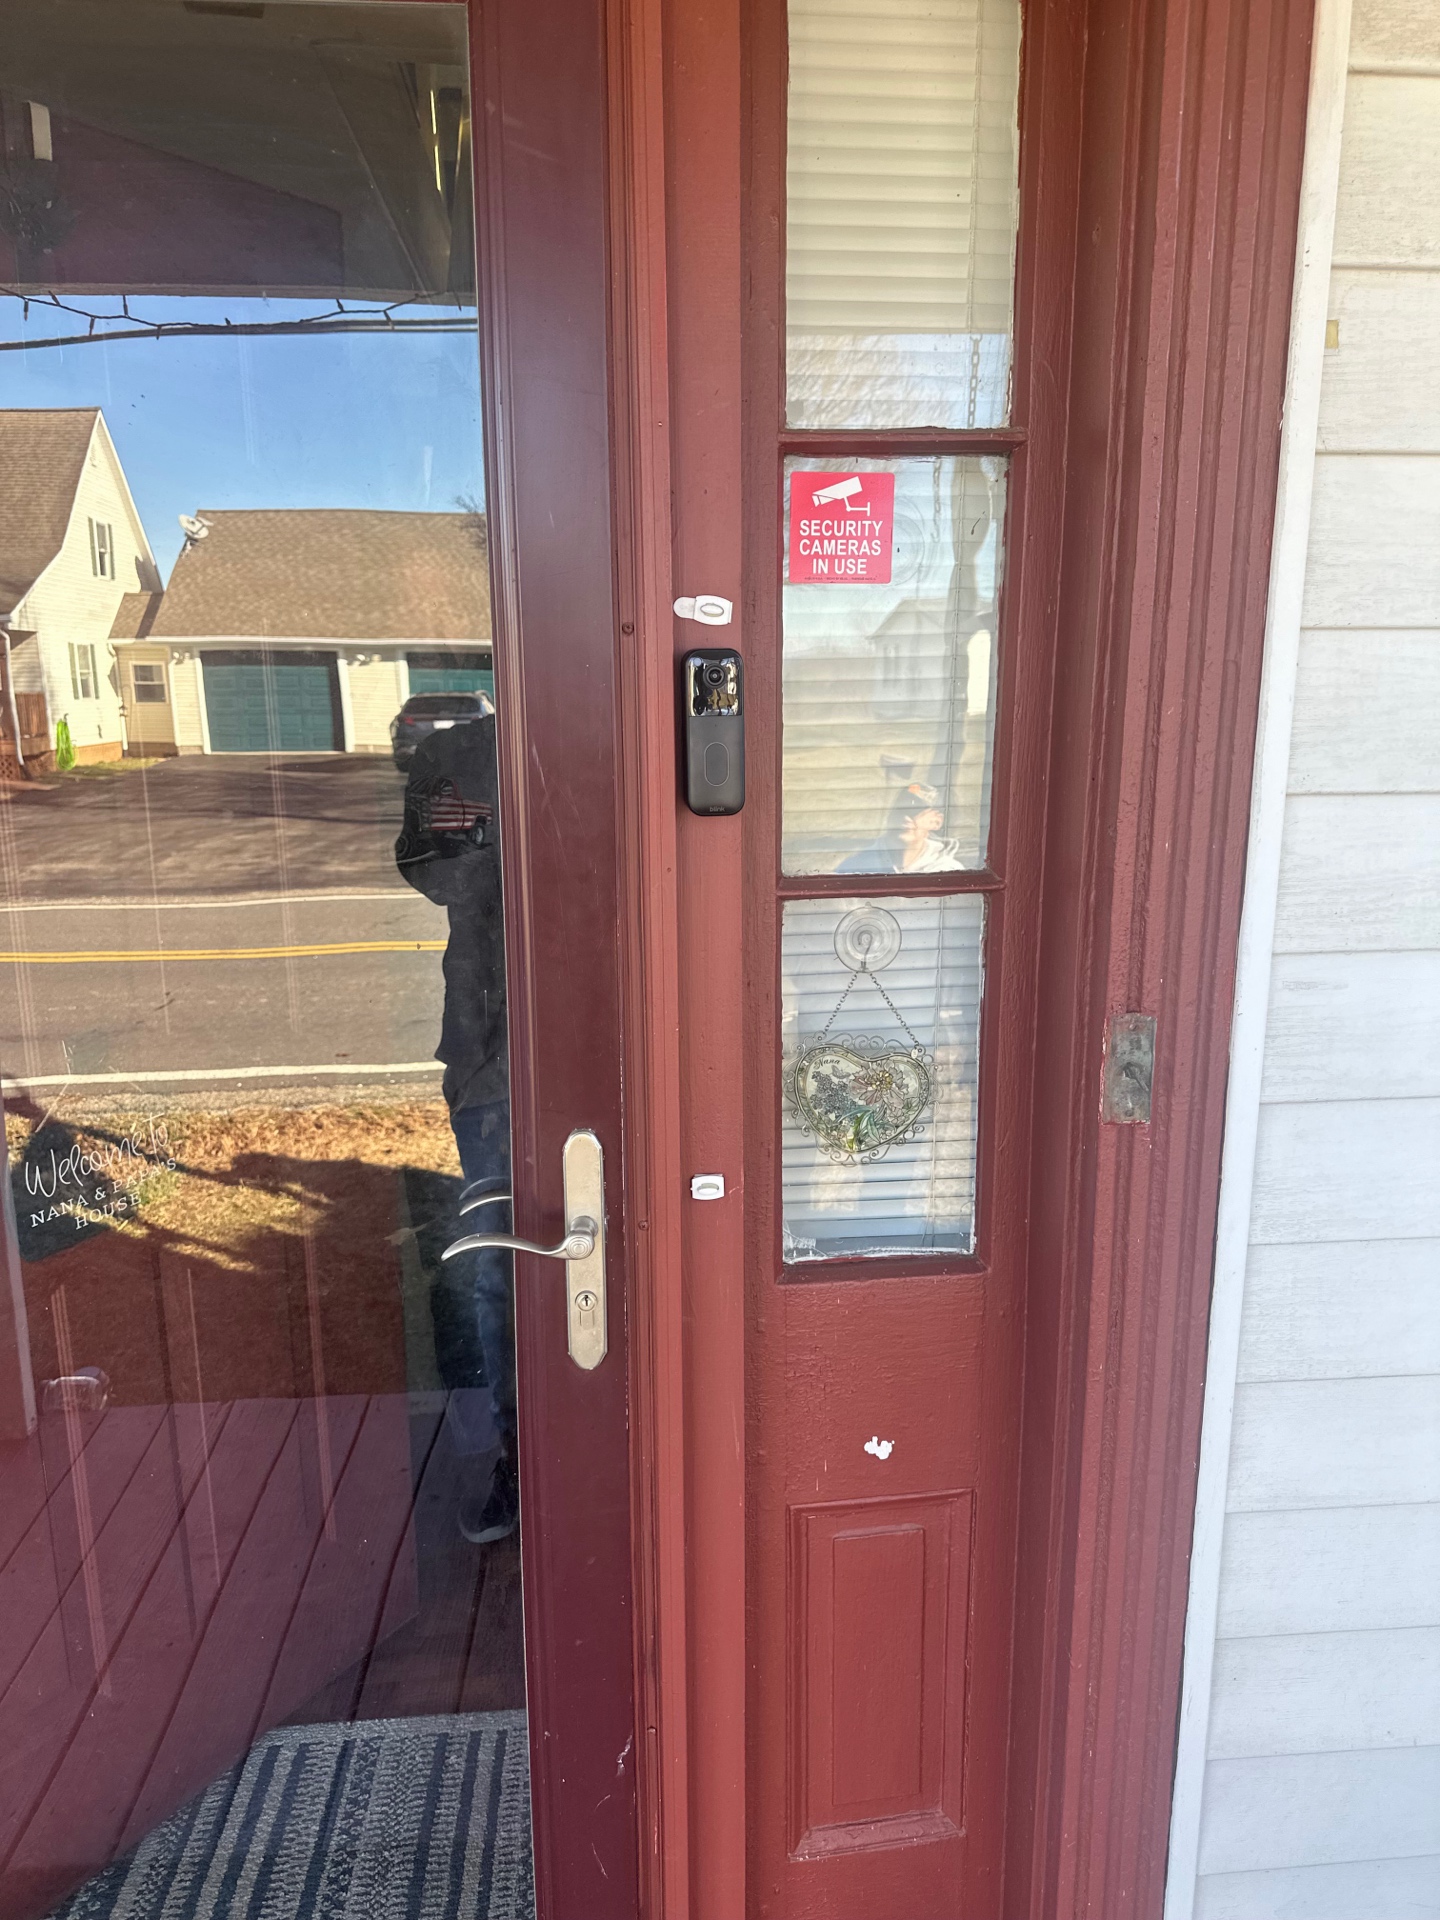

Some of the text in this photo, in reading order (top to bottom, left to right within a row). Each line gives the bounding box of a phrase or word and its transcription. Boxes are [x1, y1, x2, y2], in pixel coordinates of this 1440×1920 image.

[799, 519, 883, 536] SECURITY
[799, 539, 882, 555] CAMERAS
[812, 558, 868, 574] IN USE
[814, 1056, 841, 1069] Nana
[25, 1131, 143, 1198] Welcome
[29, 1157, 177, 1228] NANA & PAPA'S
[74, 1191, 142, 1230] HOUSE
